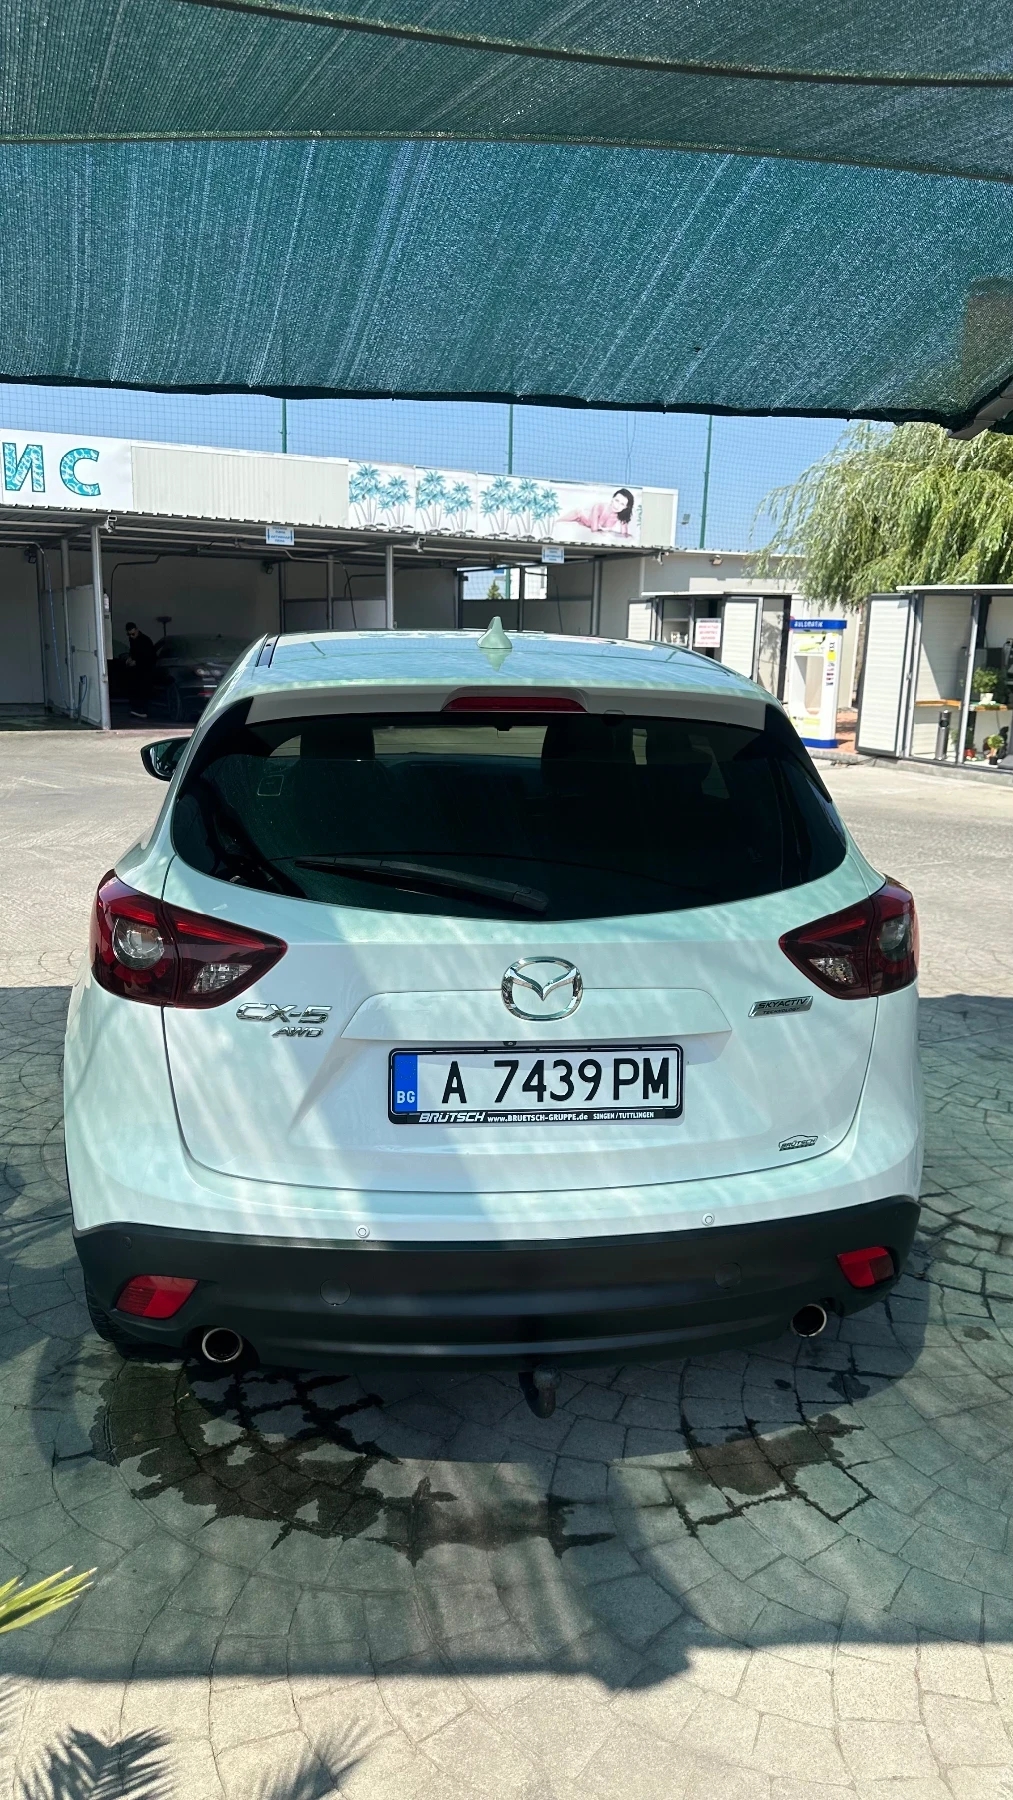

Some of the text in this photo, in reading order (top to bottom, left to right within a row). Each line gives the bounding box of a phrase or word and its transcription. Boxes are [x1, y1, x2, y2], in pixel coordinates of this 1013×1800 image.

[758, 998, 808, 1009] SKYACTIV
[235, 1002, 332, 1024] CX-5
[271, 1026, 323, 1038] AWD
[441, 1060, 467, 1104] A
[494, 1058, 602, 1103] 7439
[396, 1090, 416, 1104] BG
[418, 1111, 486, 1123] BRÜTSCH
[487, 1112, 589, 1123] www.BRUETSCH-GRUPPE.de
